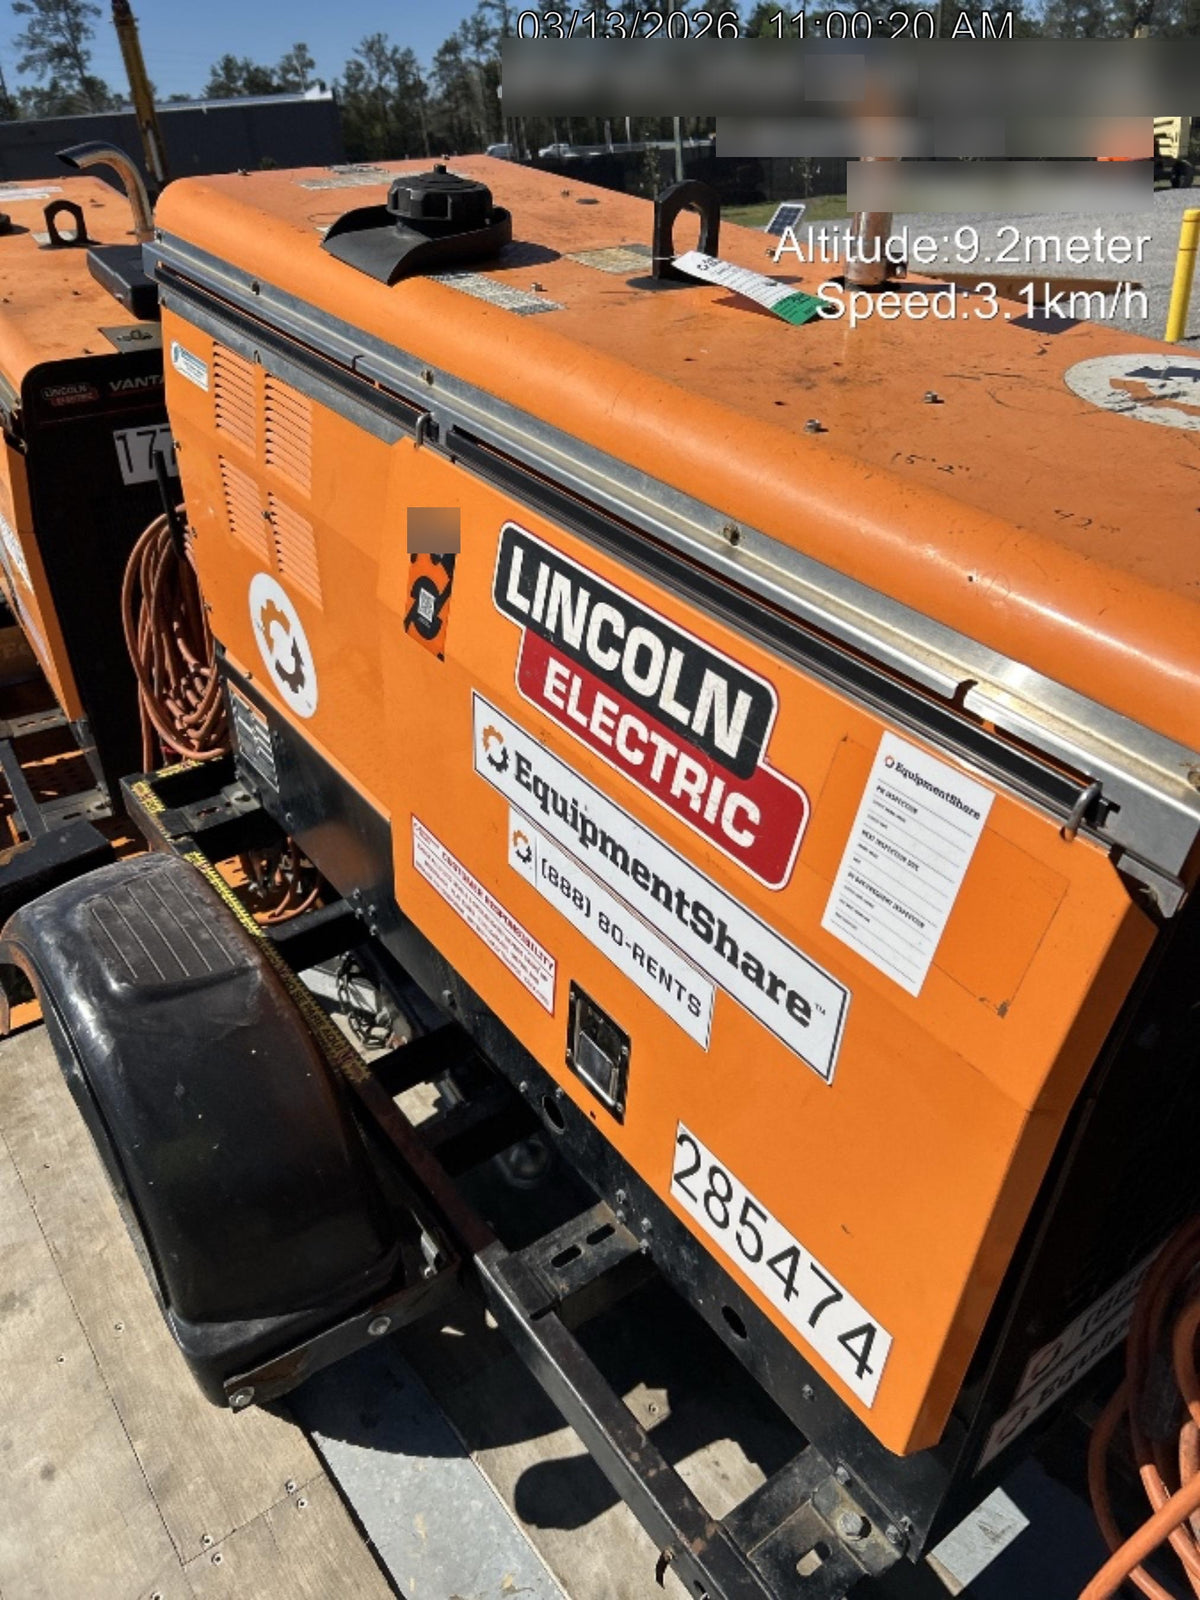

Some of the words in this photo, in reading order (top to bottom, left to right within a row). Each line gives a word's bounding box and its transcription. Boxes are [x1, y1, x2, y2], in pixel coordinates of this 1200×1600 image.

[506, 545, 752, 759] LINCOLN
[543, 656, 761, 848] ELECTRIC
[541, 857, 592, 918] (888)
[597, 911, 702, 1018] 80-RENTS
[673, 1133, 877, 1380] 285474
